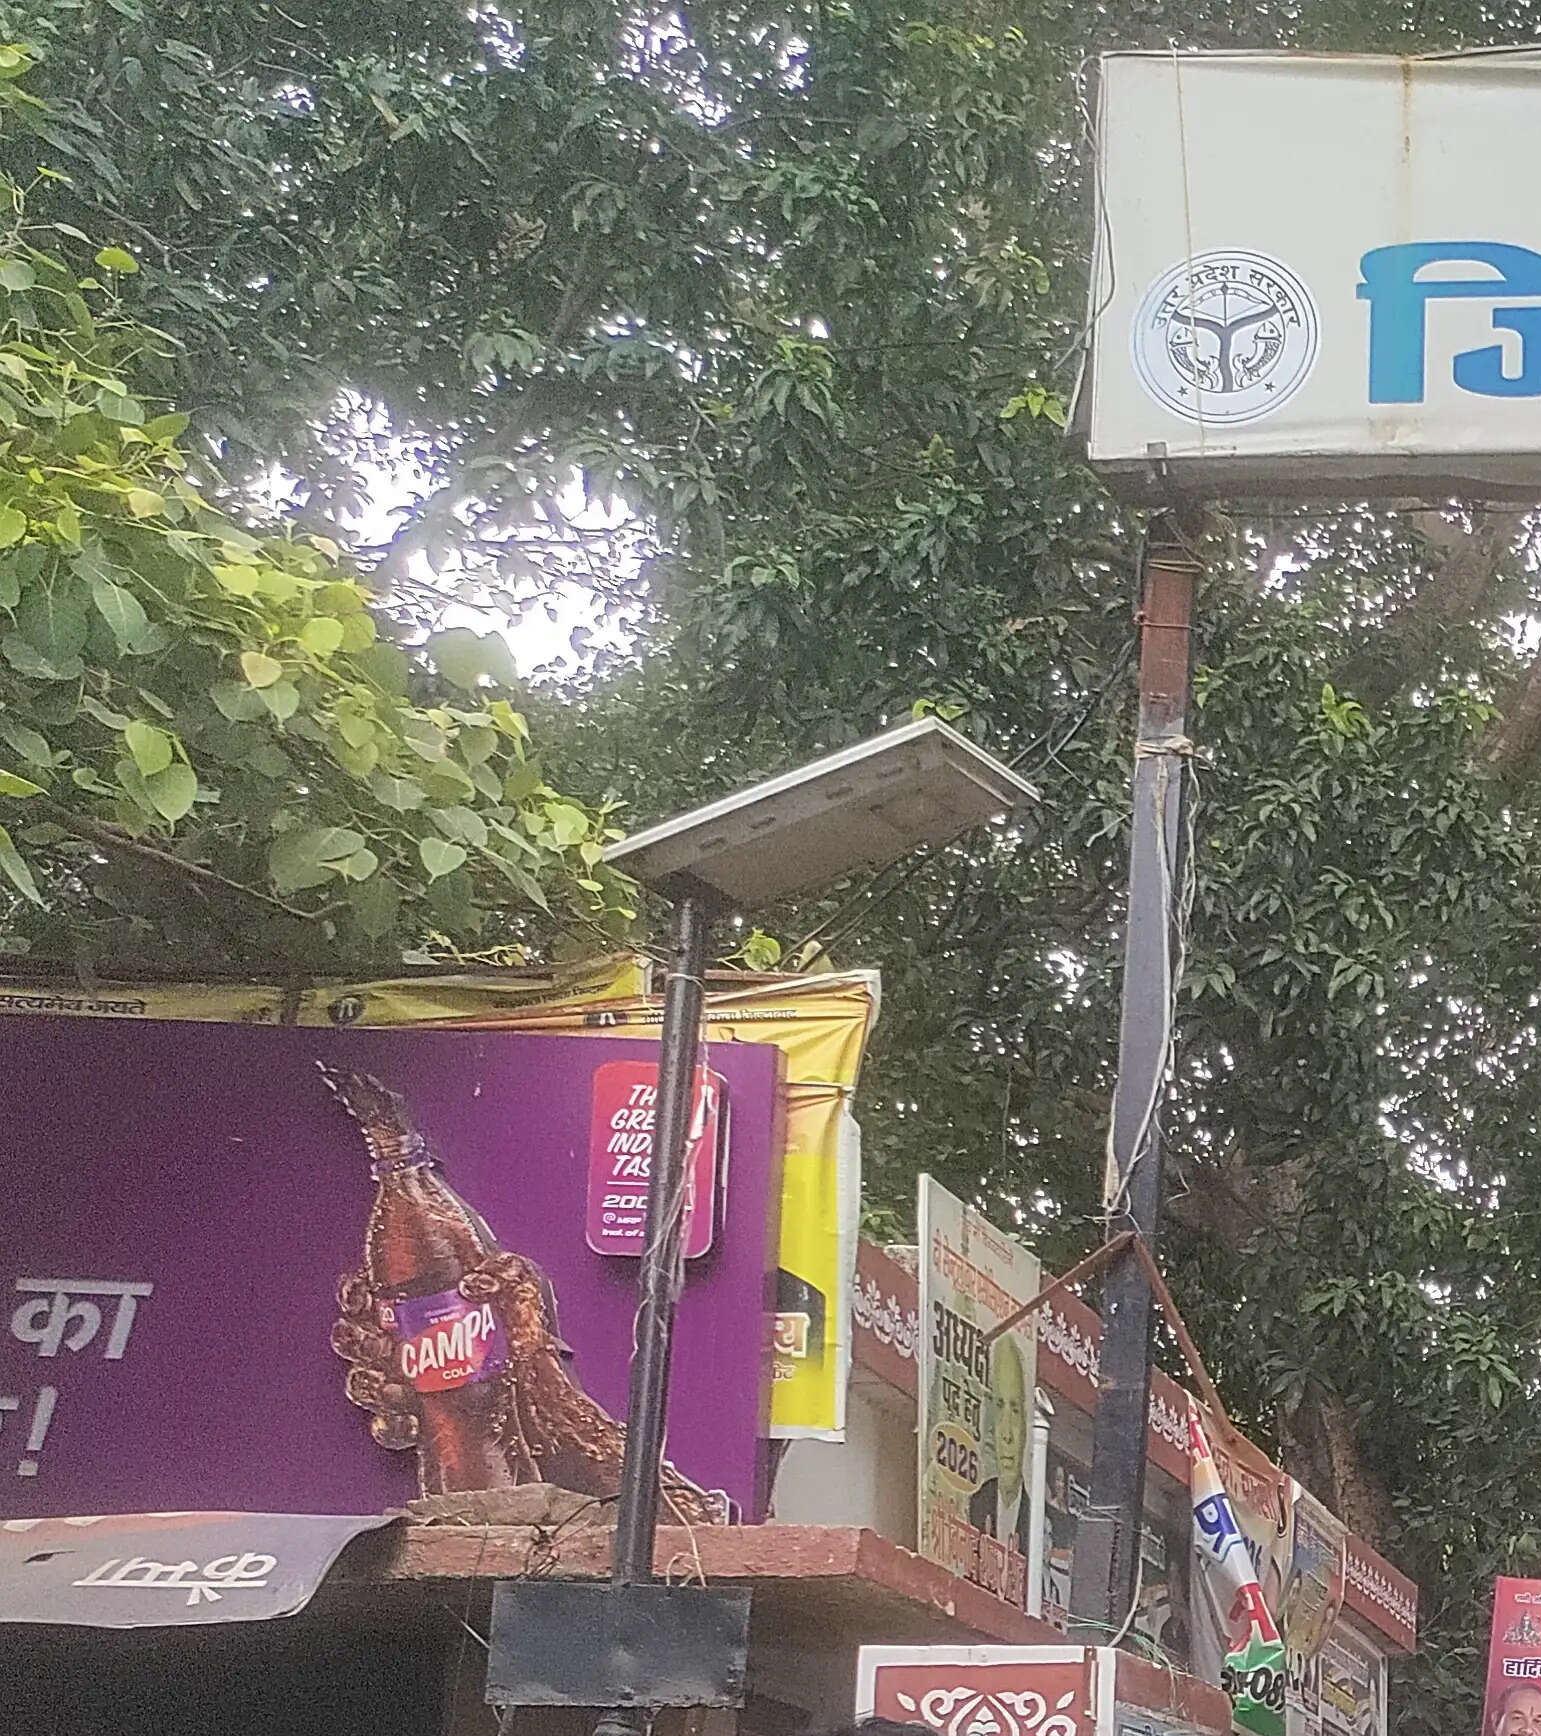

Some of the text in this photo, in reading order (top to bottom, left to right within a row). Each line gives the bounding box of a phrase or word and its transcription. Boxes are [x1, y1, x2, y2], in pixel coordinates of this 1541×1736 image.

[1185, 265, 1240, 288] प्रदेश
[1249, 269, 1301, 328] सरकार
[629, 1084, 658, 1106] TH
[610, 1108, 656, 1130] GRE
[612, 1155, 652, 1178] TAS
[10, 1279, 153, 1361] का
[401, 1303, 496, 1379] CAMPA
[442, 1364, 475, 1380] COLA
[935, 1430, 979, 1485] 2026
